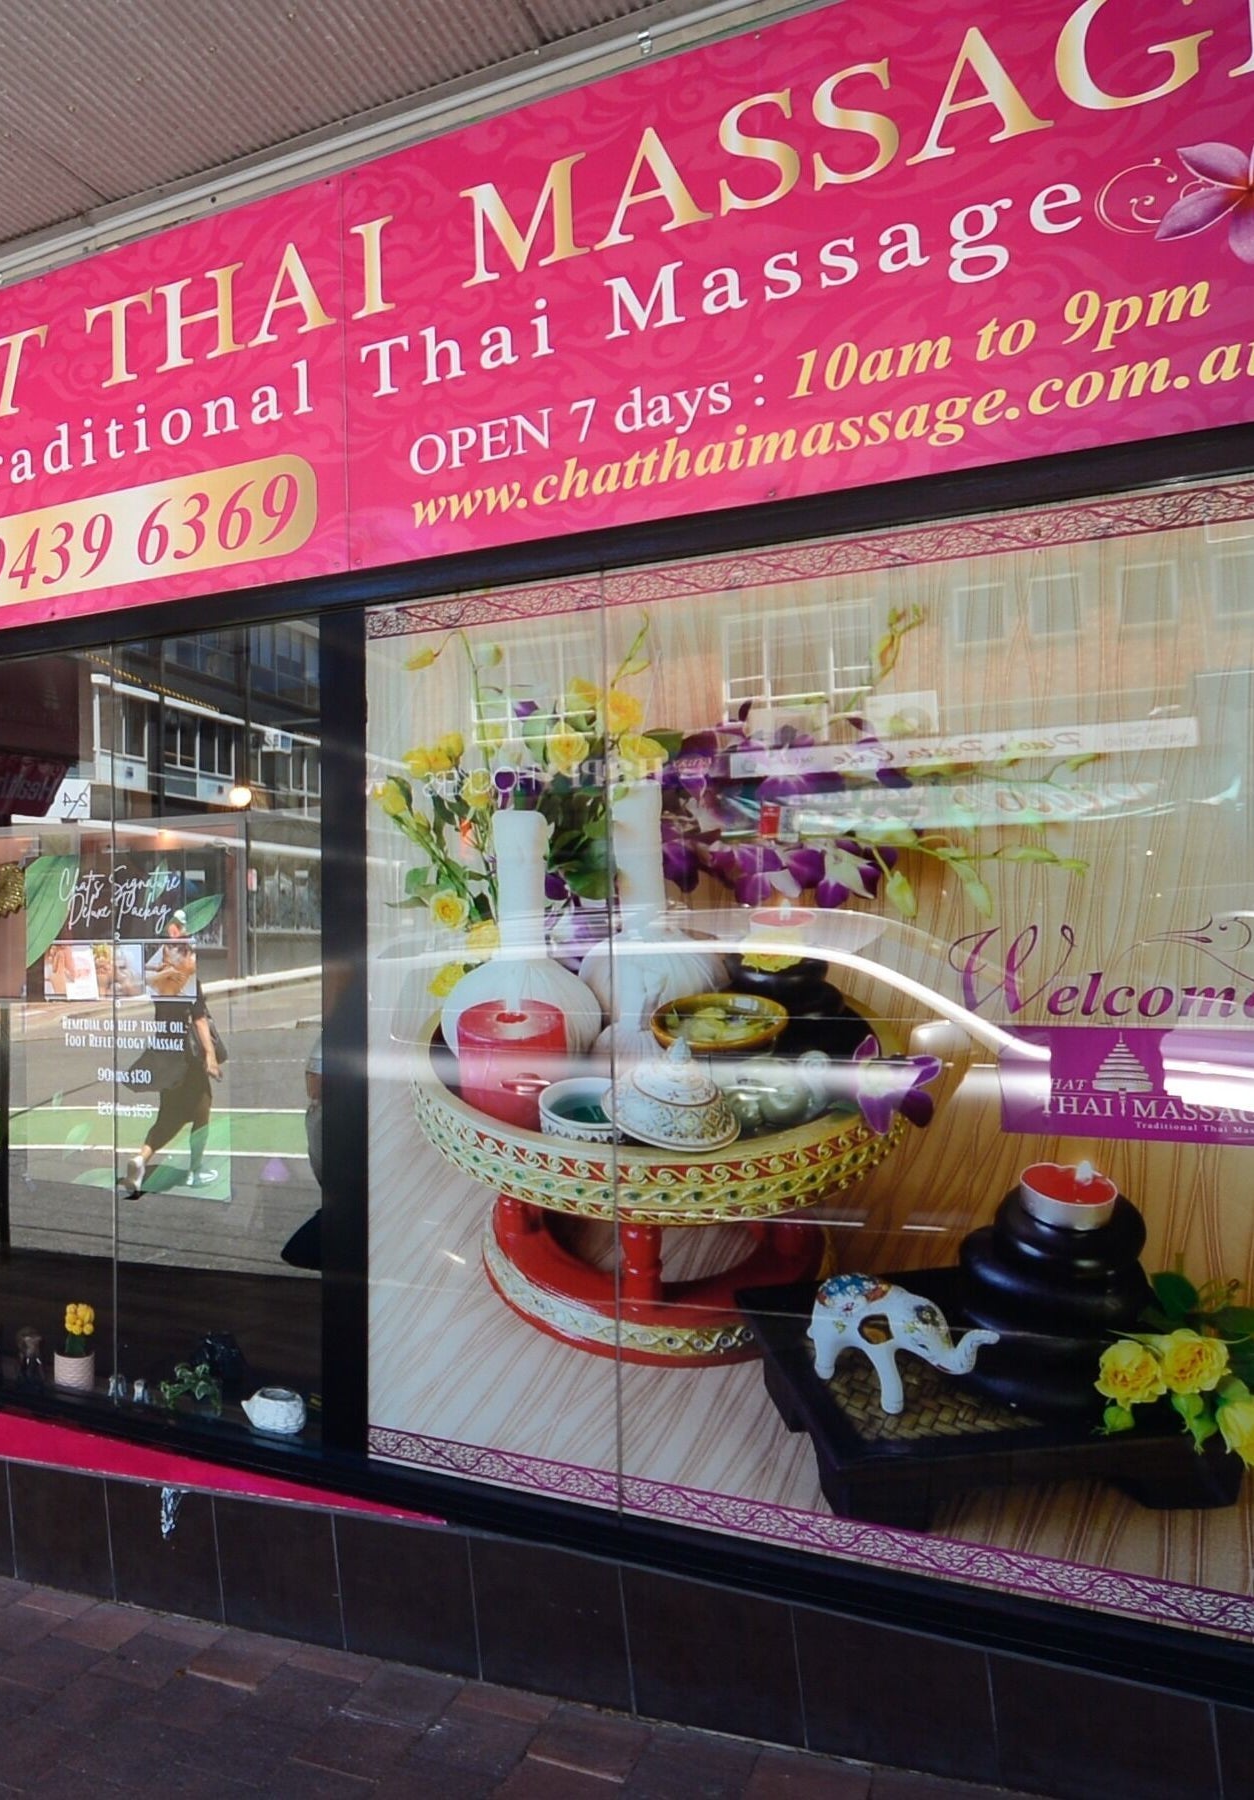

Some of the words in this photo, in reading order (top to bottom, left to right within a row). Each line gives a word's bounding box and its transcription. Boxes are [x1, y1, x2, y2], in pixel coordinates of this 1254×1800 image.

[84, 214, 394, 388] THAI
[459, 0, 1254, 287] MASSAG
[359, 298, 555, 399] Thai
[603, 182, 1082, 340] Massage
[409, 407, 553, 476] OPEN
[569, 398, 596, 443] 7
[614, 381, 732, 434] days
[788, 335, 952, 400] 10am
[975, 316, 1037, 362] to
[1062, 281, 1210, 352] 9pm
[411, 341, 1254, 528] www.chatthaimassage.com.a
[136, 472, 298, 562] 6369
[1050, 1078, 1088, 1091] HAT
[1133, 1099, 1254, 1124] MASSA
[1136, 1121, 1197, 1132] Traditional
[1204, 1123, 1228, 1134] Thai
